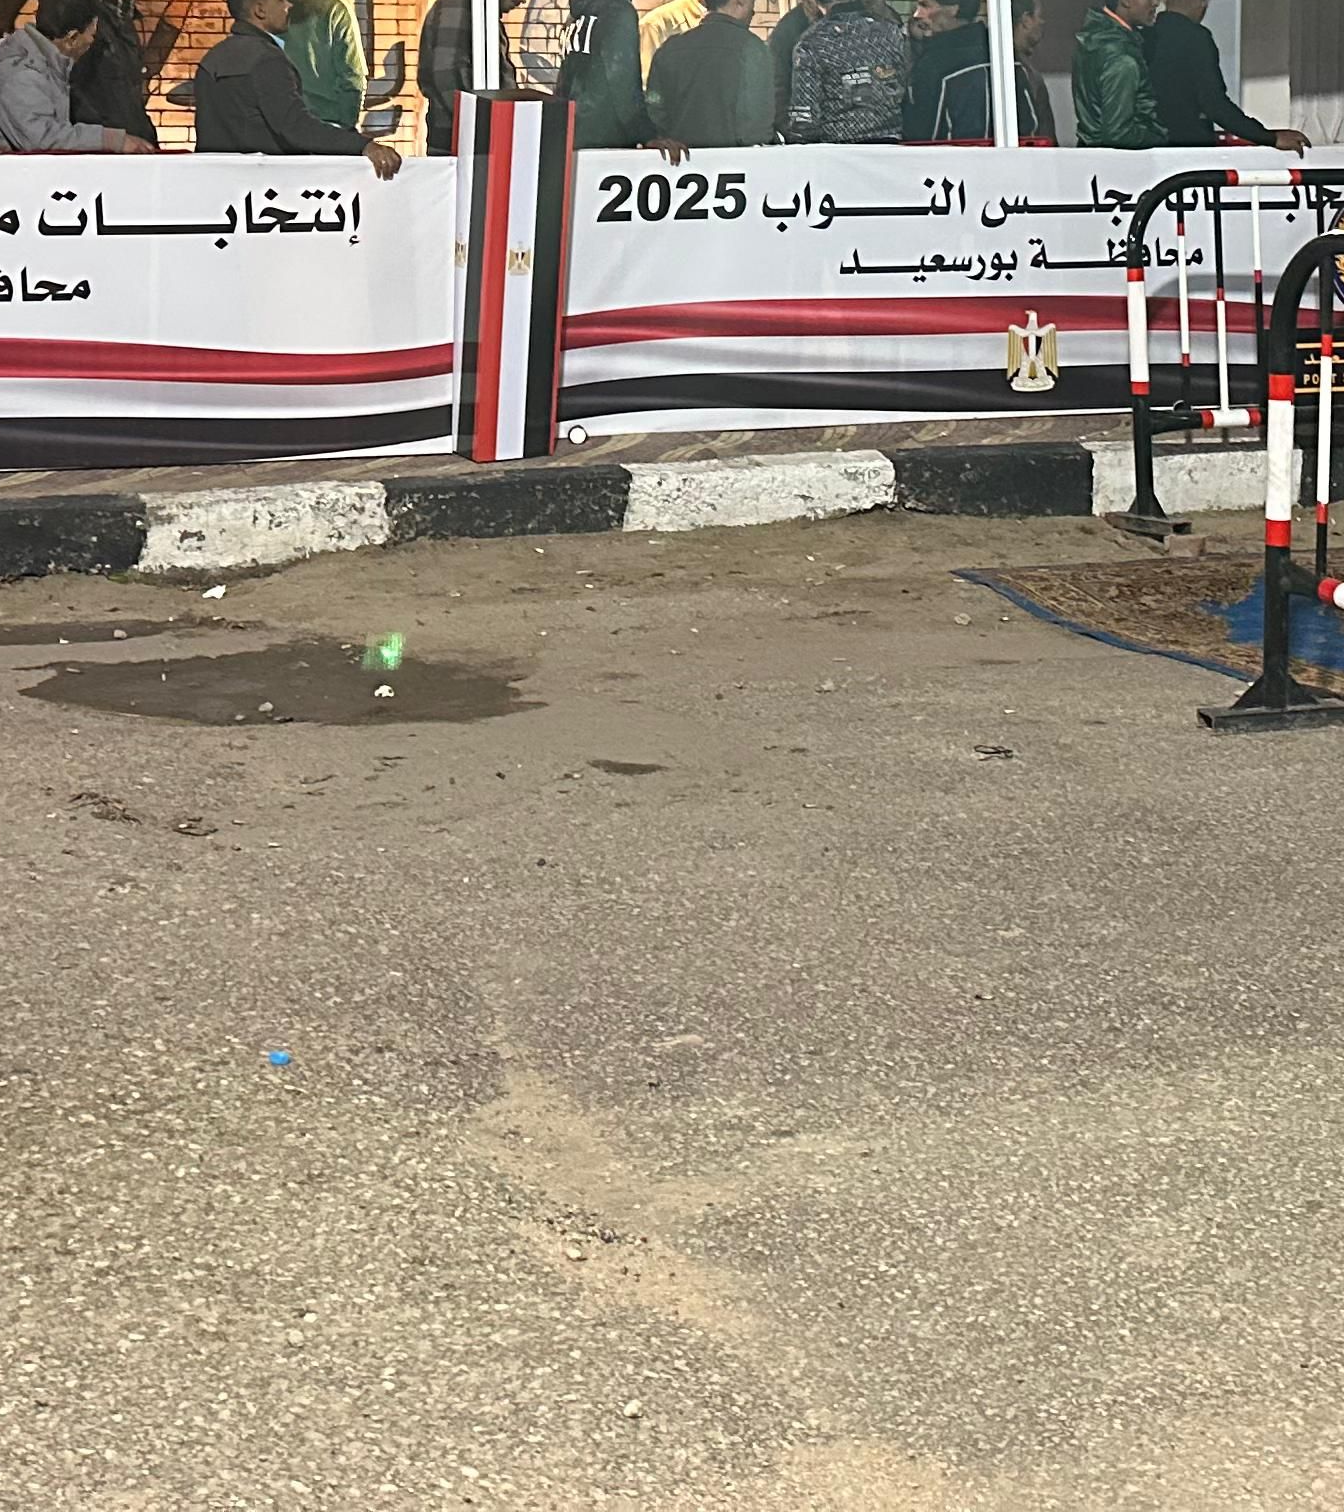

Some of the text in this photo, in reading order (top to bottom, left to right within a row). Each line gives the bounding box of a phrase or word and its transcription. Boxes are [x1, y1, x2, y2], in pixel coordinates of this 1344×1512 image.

[38, 189, 362, 251] إنتخابات
[596, 173, 747, 223] 2025
[762, 177, 966, 232] النواب
[839, 248, 1018, 284] بورسعيد
[1303, 372, 1336, 386] POT
